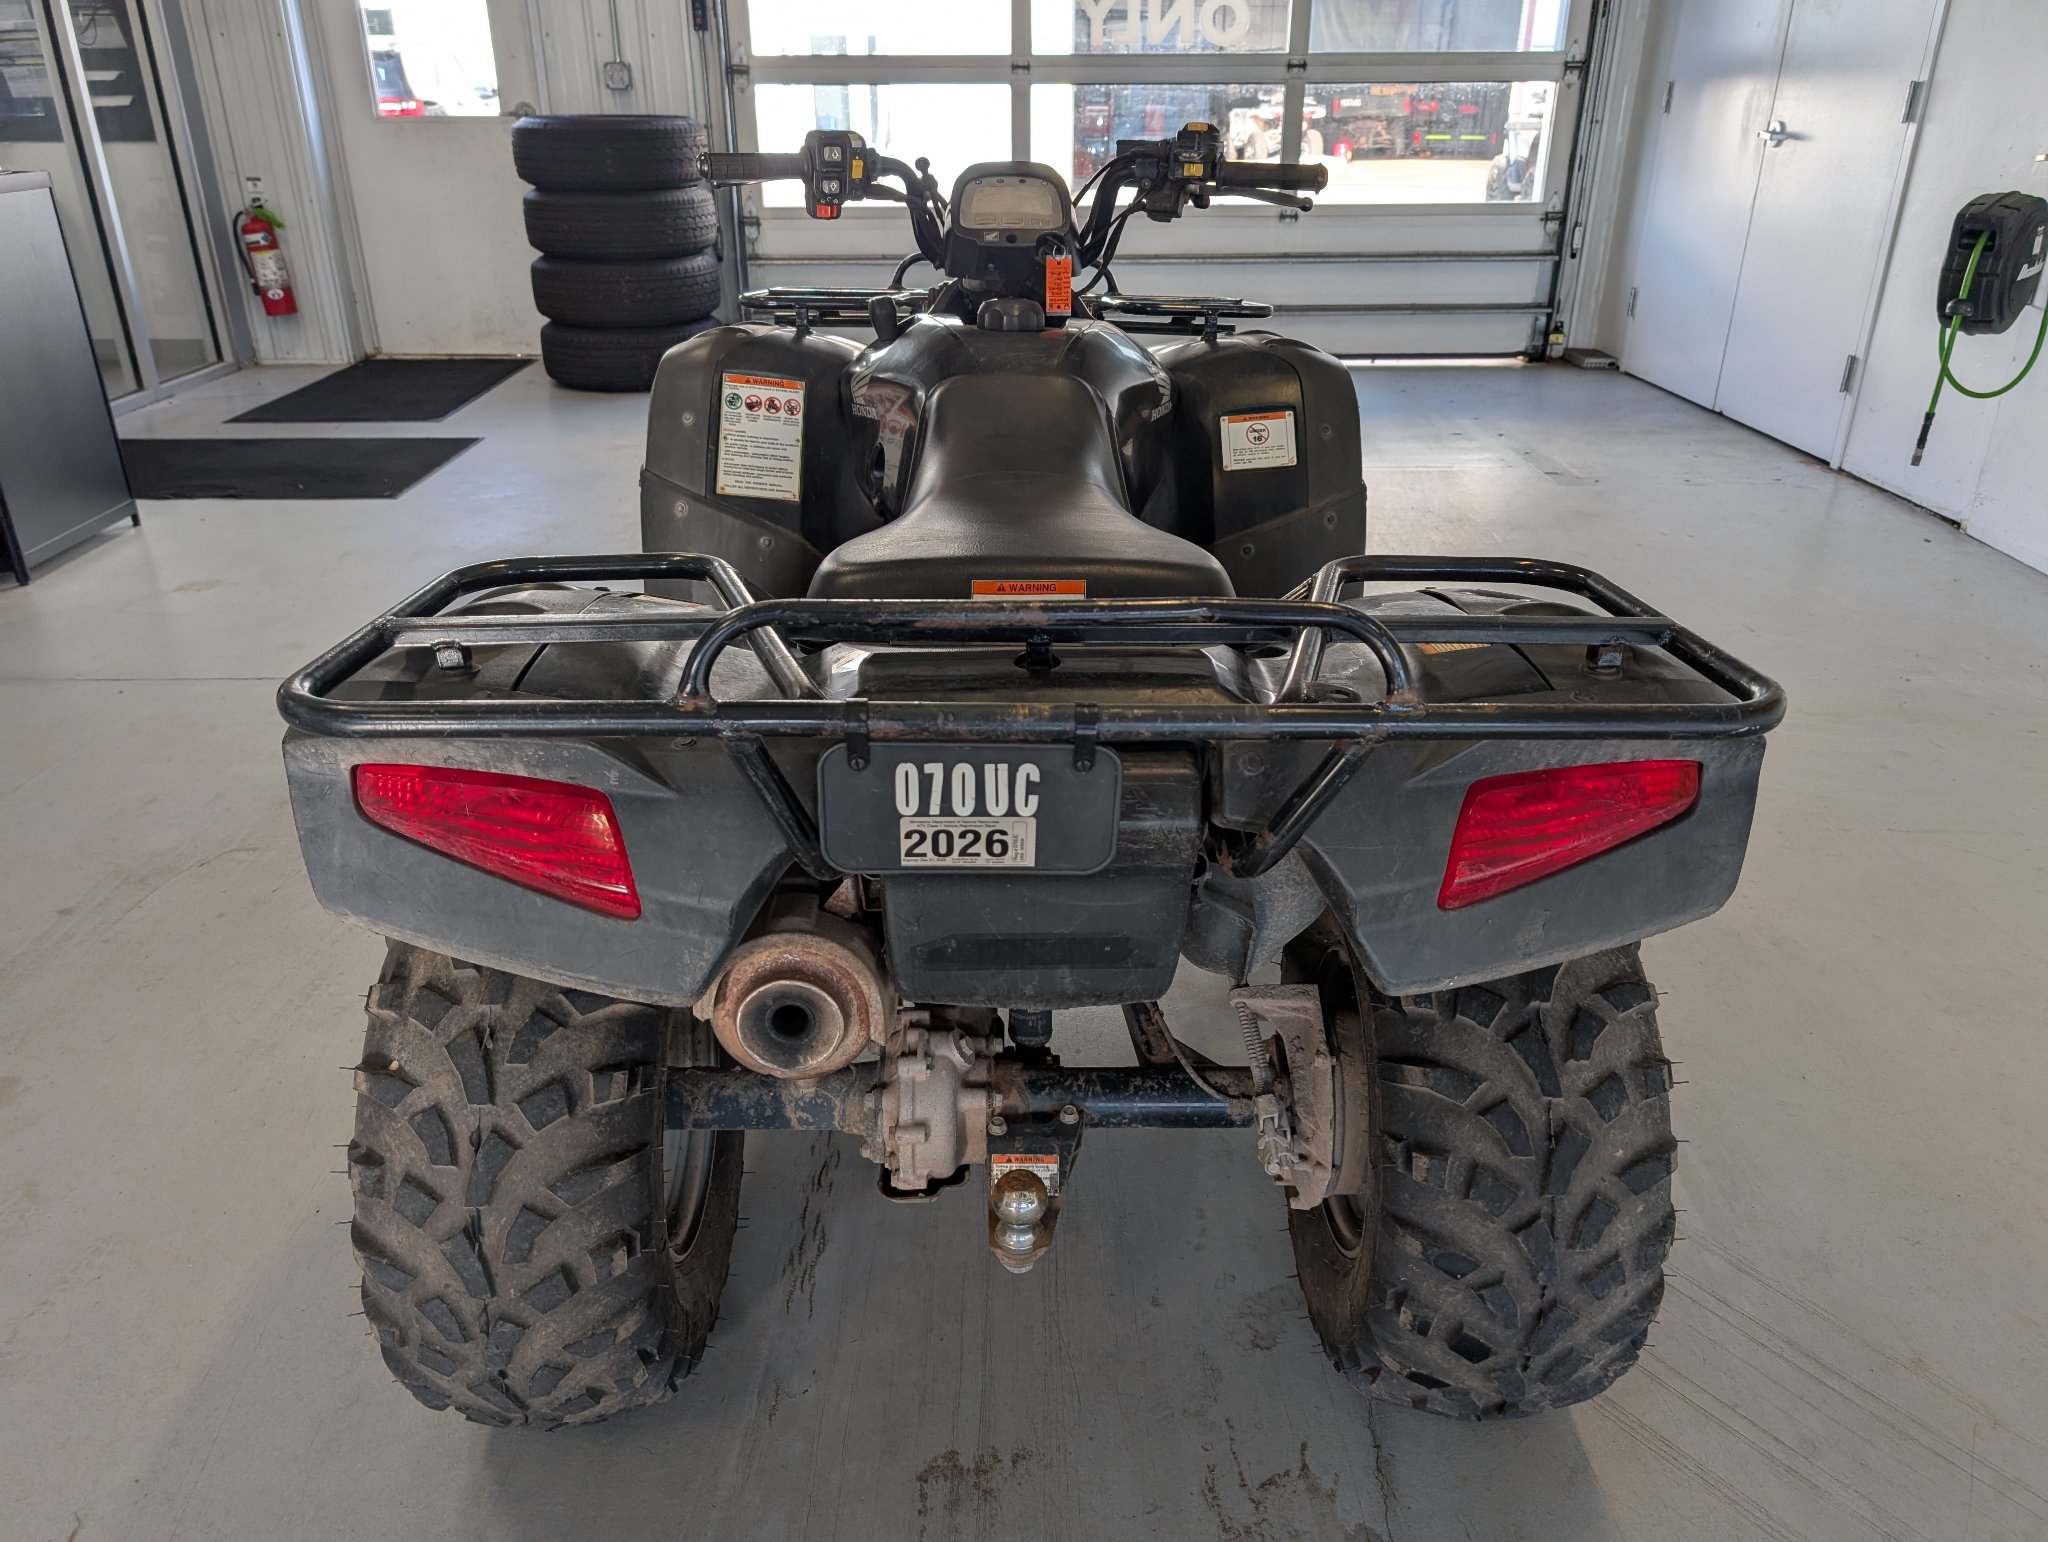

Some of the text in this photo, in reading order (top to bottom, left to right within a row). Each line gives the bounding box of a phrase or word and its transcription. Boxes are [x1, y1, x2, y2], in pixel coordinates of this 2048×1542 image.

[752, 378, 785, 387] WARNING
[851, 403, 878, 420] HONDA
[1008, 583, 1057, 592] WARNING
[895, 762, 1040, 817] 070UC
[904, 829, 1009, 858] 2026
[1014, 1155, 1045, 1163] WARNING
